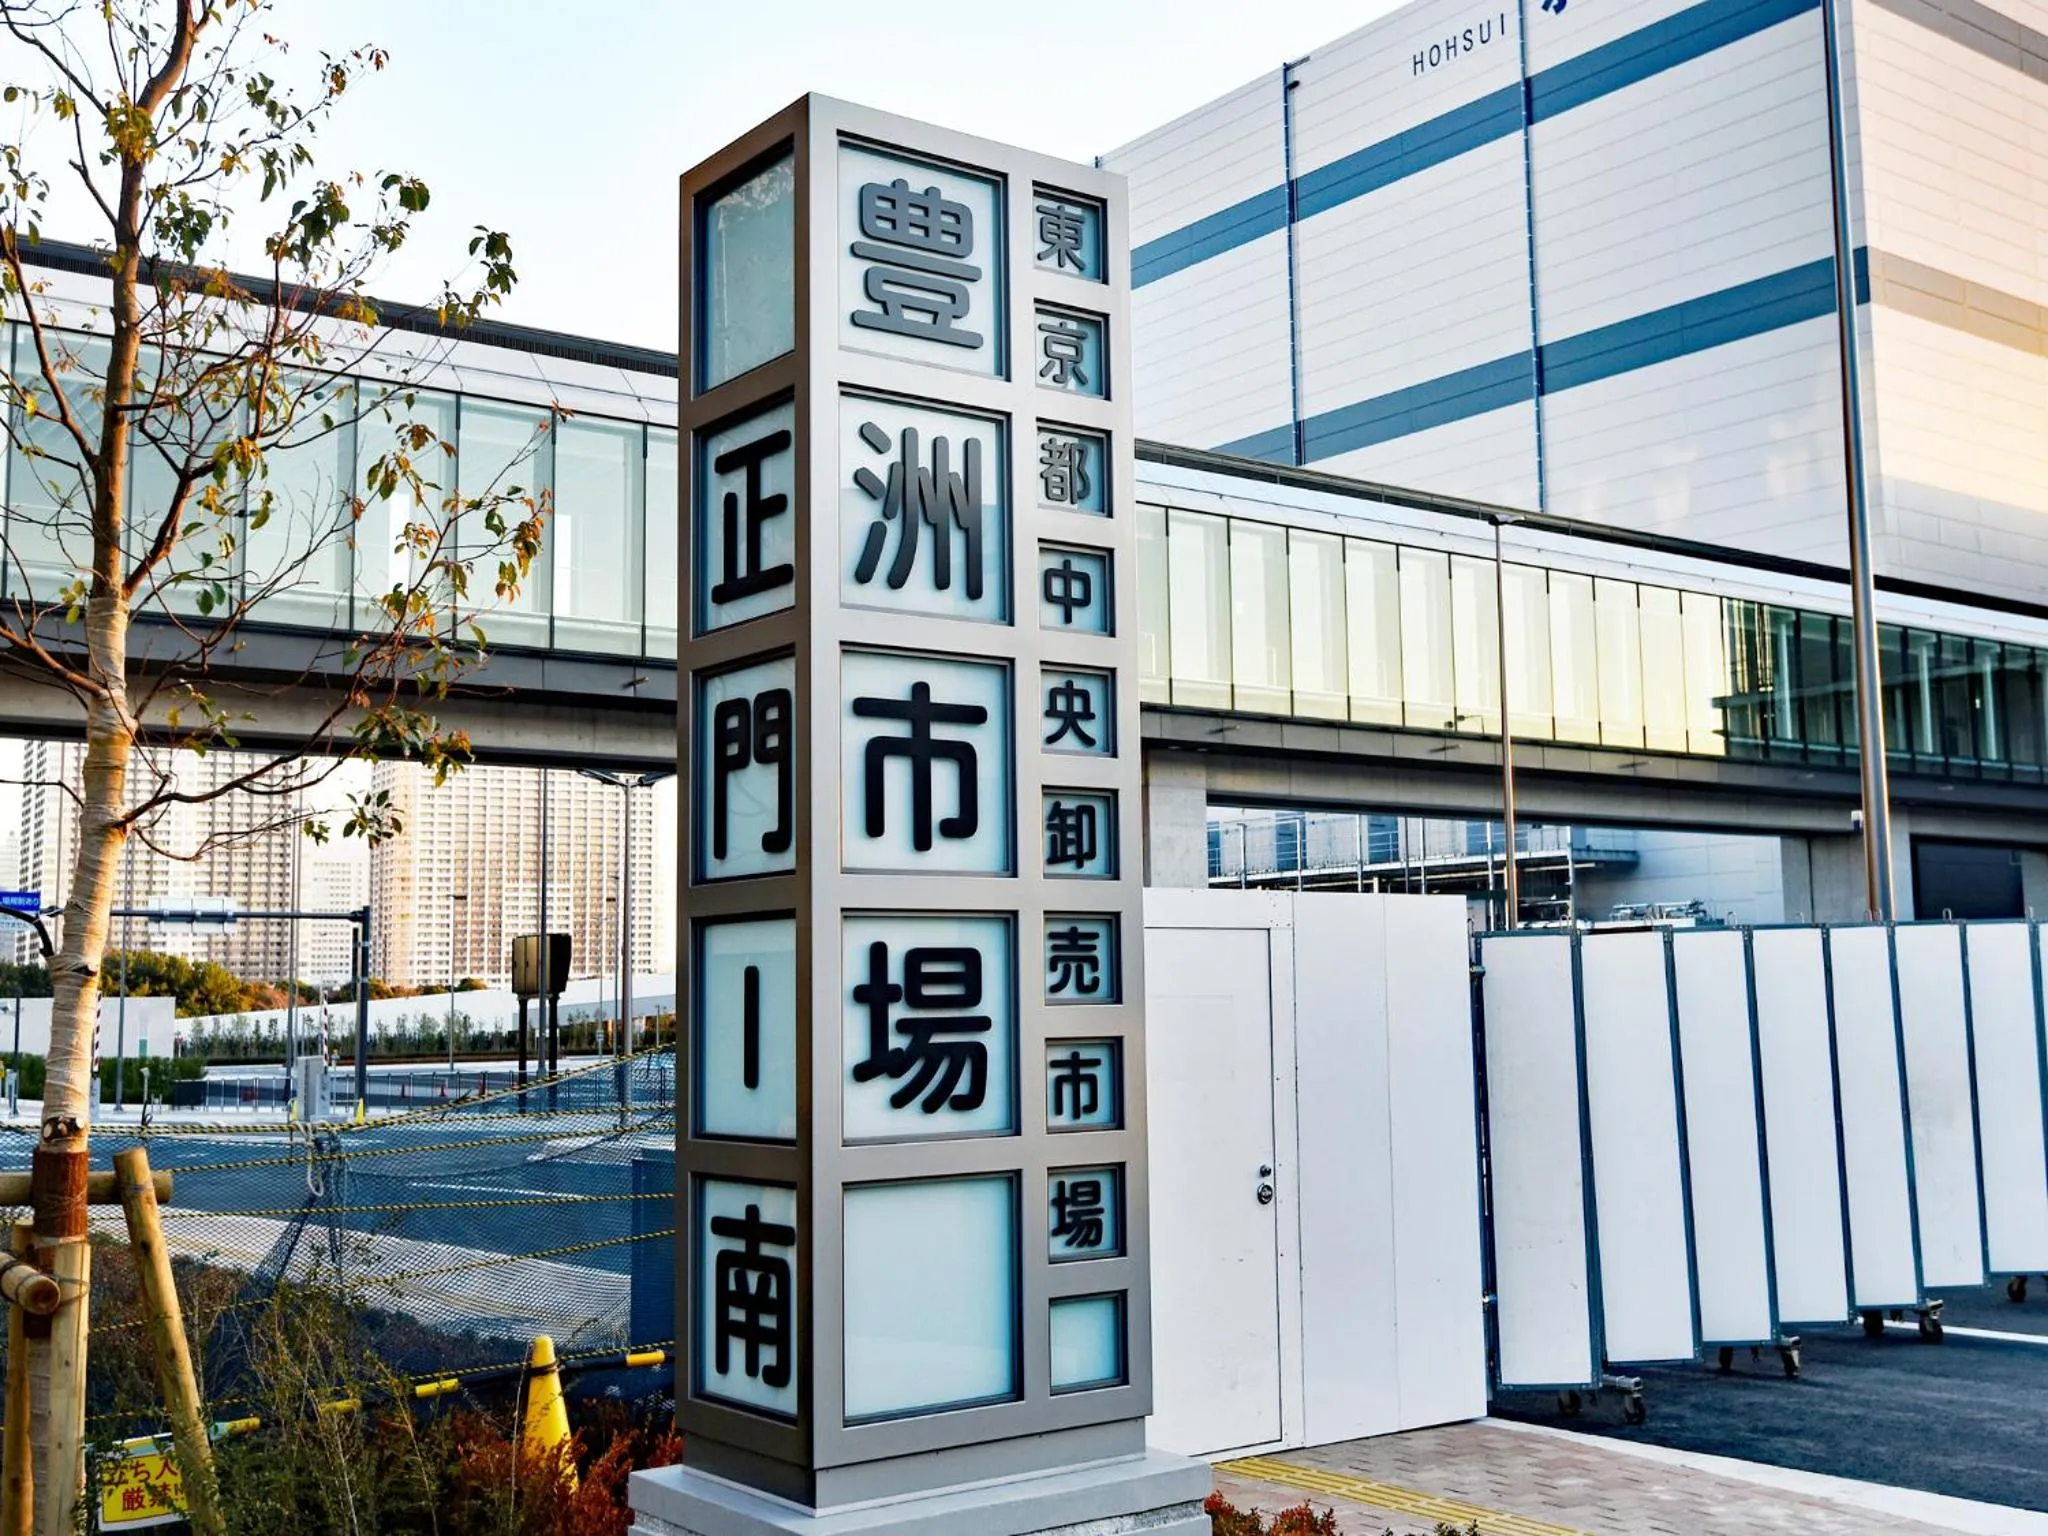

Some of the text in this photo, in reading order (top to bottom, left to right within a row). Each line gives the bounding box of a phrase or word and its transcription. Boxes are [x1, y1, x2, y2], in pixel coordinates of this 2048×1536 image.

[1412, 12, 1505, 76] HOHSUI
[850, 178, 992, 1114] 豊洲市場
[1036, 203, 1105, 1248] 東京都中央卸売市場
